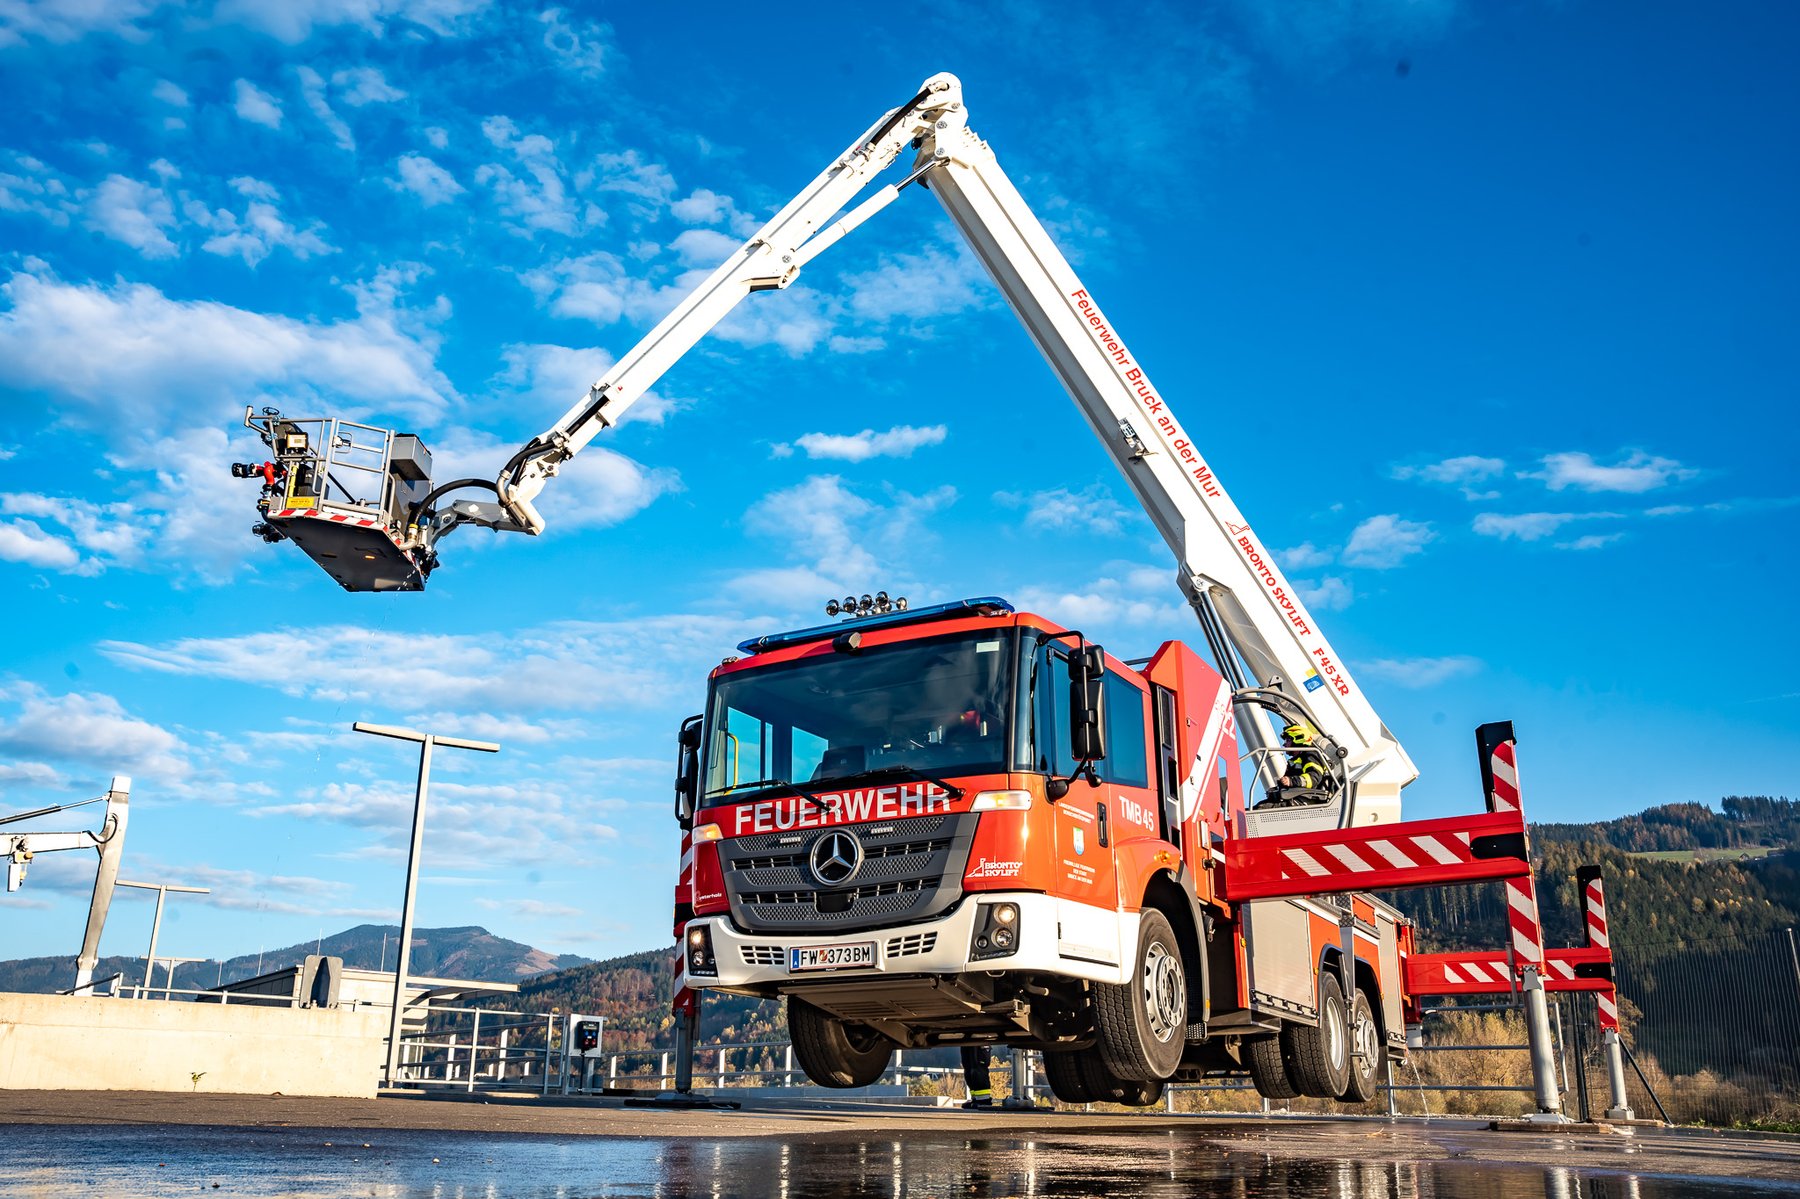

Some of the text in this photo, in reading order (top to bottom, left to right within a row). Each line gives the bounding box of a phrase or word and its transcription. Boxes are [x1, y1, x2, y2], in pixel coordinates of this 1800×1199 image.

[1071, 288, 1221, 497] Feuerwehr Bruck an der Mur
[1237, 535, 1277, 587] BRONTO
[1272, 586, 1312, 636] SKYLIFT
[734, 783, 951, 835] FEUERWEHR
[984, 861, 1021, 870] BRONTO
[984, 869, 1019, 877] SKYLIFT
[800, 949, 819, 966] FW
